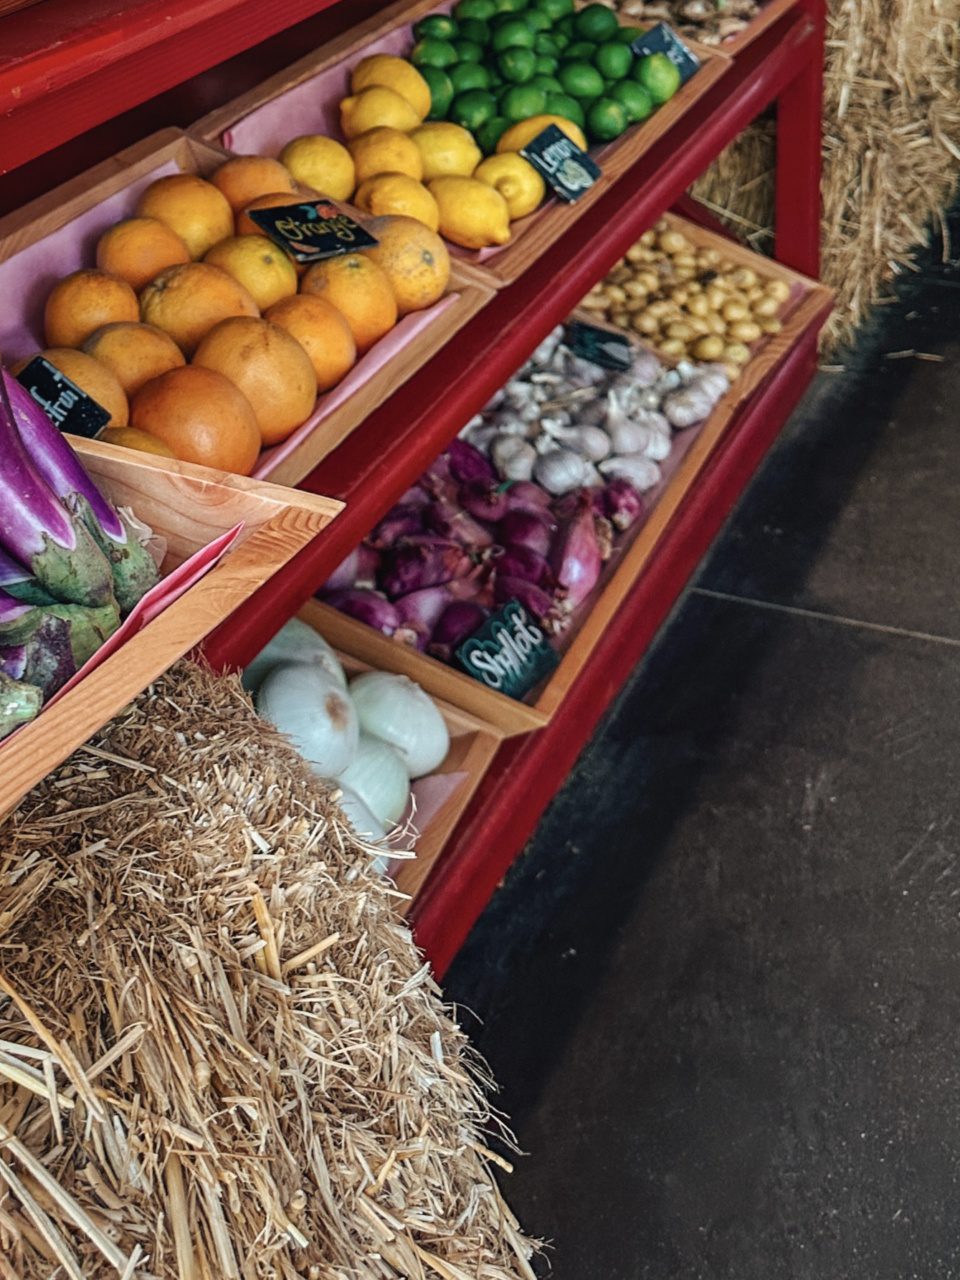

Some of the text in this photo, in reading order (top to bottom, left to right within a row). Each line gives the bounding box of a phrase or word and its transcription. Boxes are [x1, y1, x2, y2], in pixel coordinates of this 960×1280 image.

[274, 216, 358, 241] Orange
[30, 361, 88, 427] fruit
[471, 608, 544, 688] Shallot
